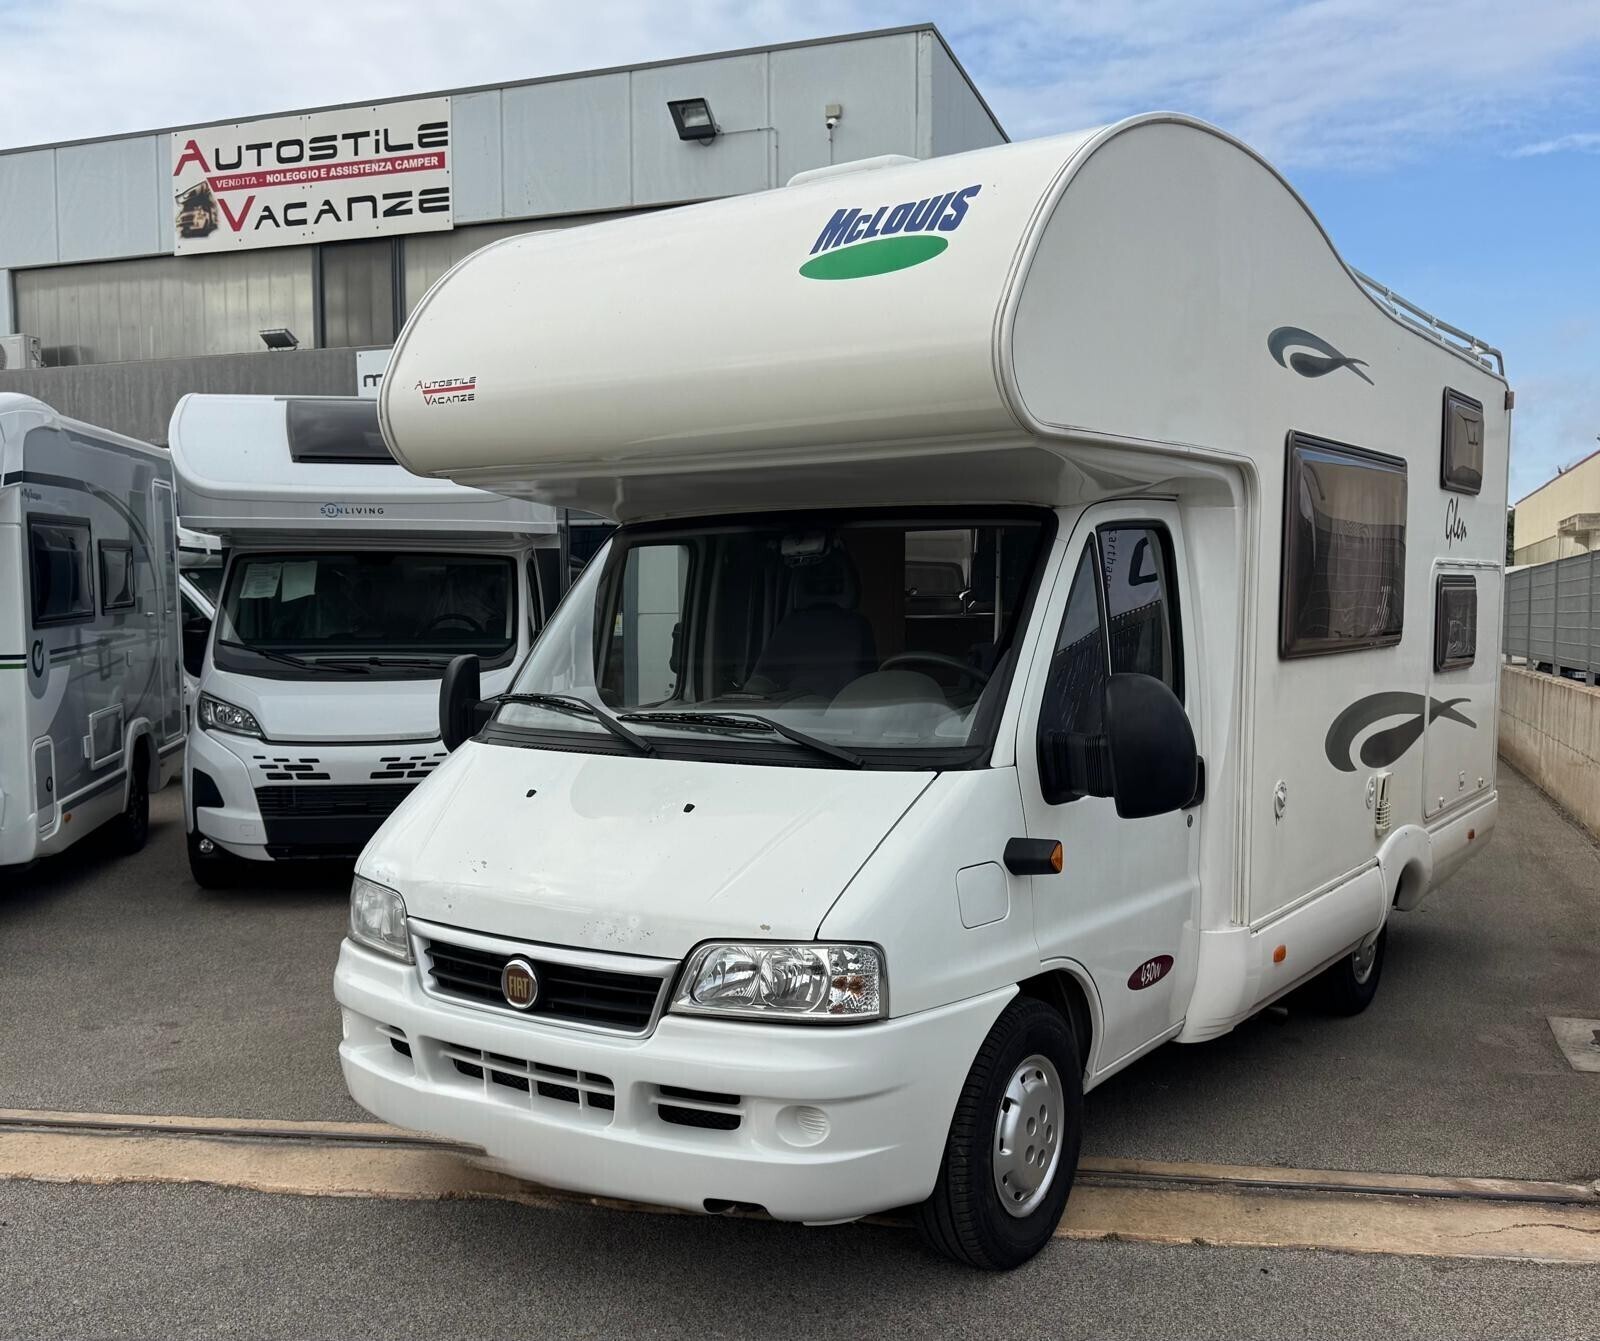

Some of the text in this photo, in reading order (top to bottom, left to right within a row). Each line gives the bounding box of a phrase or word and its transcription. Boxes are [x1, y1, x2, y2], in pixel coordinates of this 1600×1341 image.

[216, 176, 258, 189] VENDITA
[266, 169, 319, 184] NOLEGGIO
[320, 169, 328, 178] E
[329, 162, 393, 178] ASSISTENZA
[395, 156, 439, 170] CAMPER
[217, 186, 450, 232] VACANZE
[320, 505, 384, 516] SUNLIVING
[1445, 496, 1468, 550] Glen
[508, 975, 530, 999] FIAT
